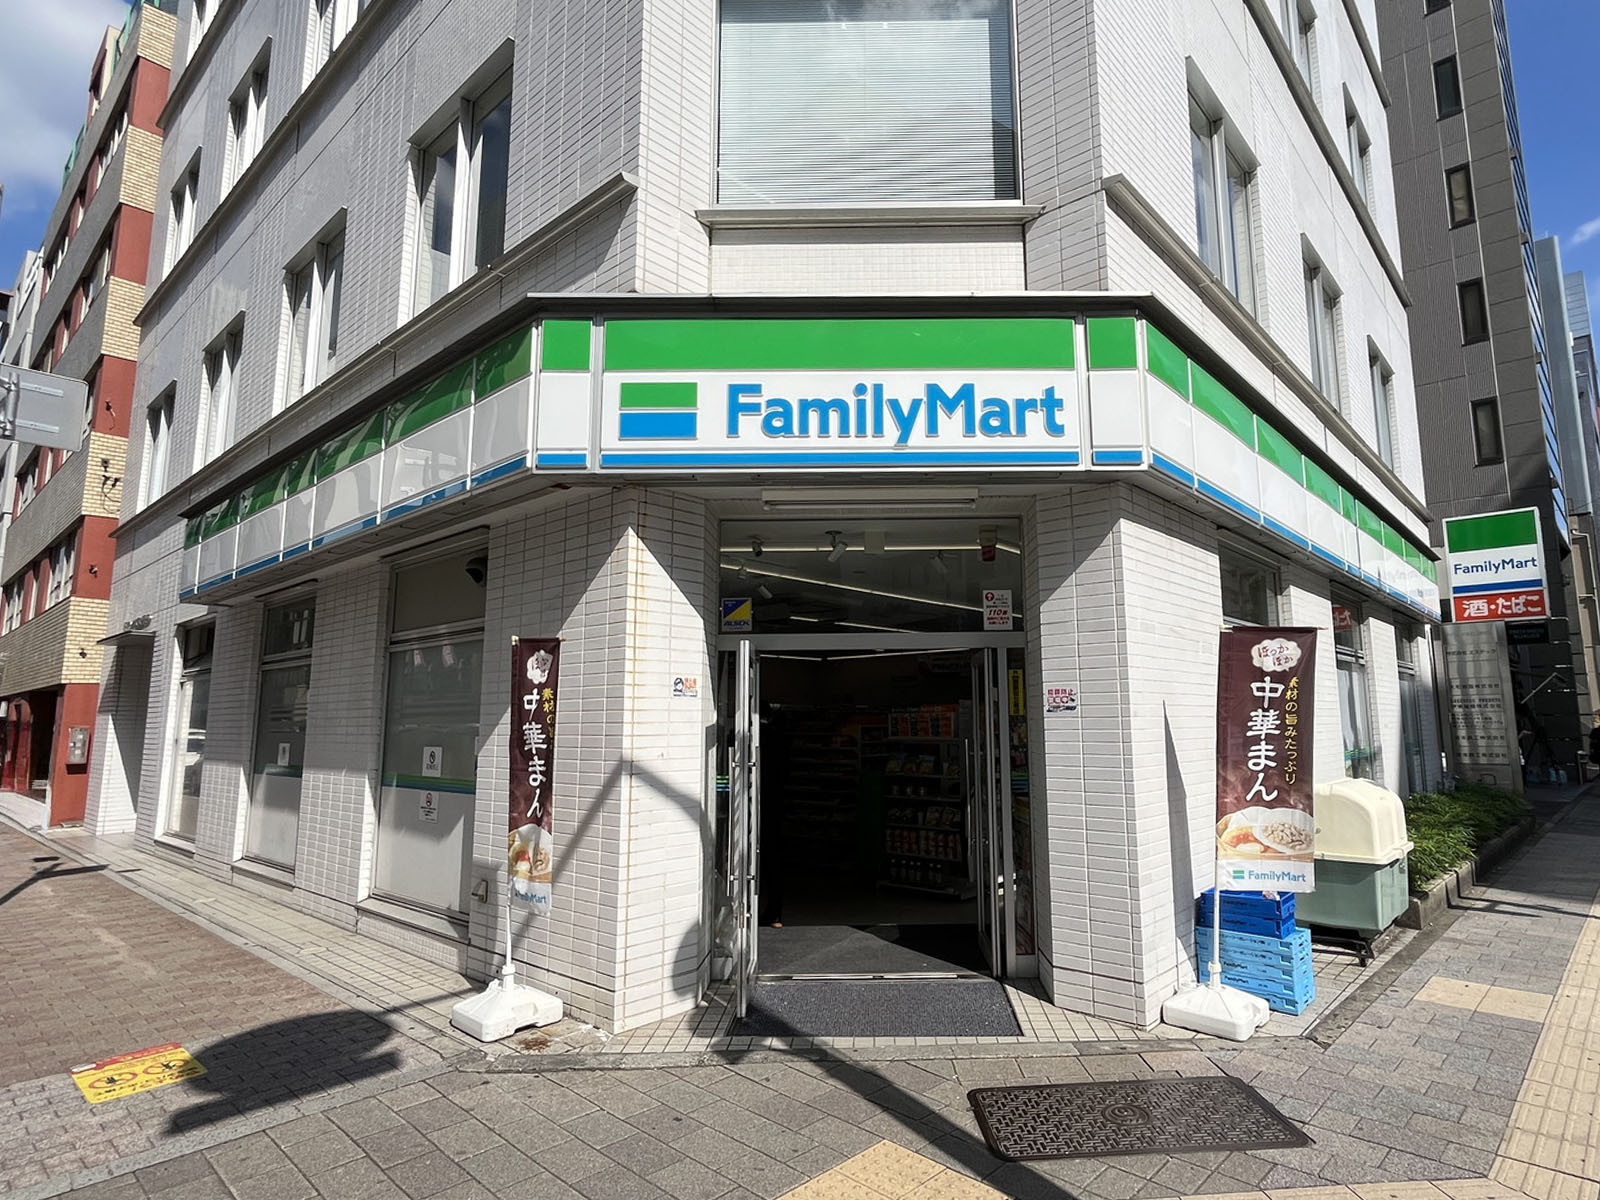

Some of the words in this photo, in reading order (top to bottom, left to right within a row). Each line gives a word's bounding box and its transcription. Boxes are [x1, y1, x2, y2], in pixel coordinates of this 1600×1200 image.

[726, 382, 1066, 449] FamilyMart
[1453, 556, 1538, 576] FamilyMart
[1462, 594, 1543, 618] 酒・たばこ
[522, 687, 548, 819] 中華まん
[1245, 676, 1285, 802] 中華まん
[1284, 676, 1300, 786] 素材の旨みたっぷり
[1247, 869, 1307, 883] FamilyMart
